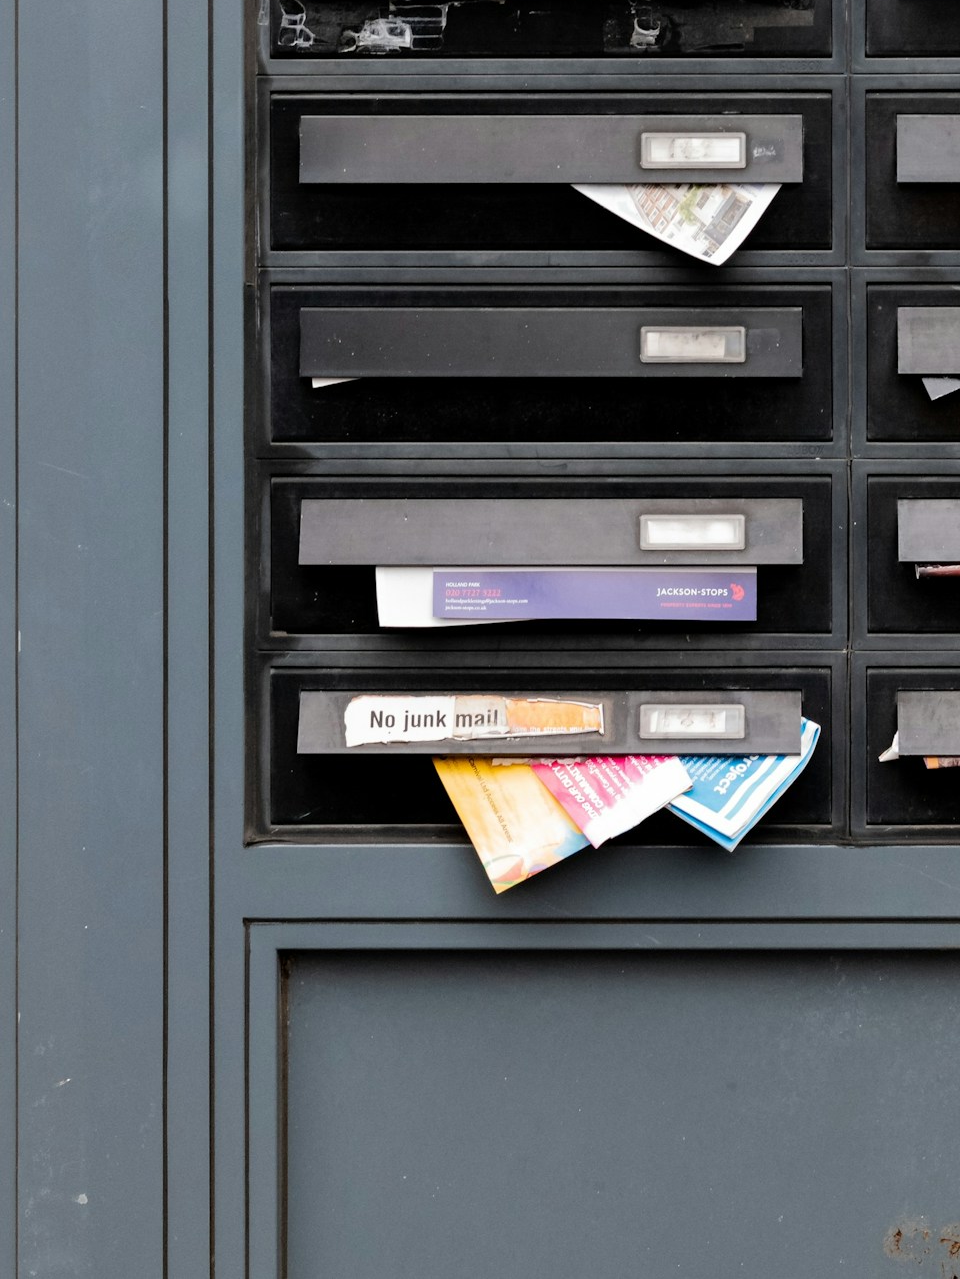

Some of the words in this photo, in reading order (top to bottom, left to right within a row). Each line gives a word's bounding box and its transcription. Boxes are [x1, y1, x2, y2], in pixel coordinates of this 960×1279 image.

[370, 710, 395, 729] No
[403, 710, 447, 732] junk
[455, 709, 498, 728] mail
[551, 763, 573, 789] DUTY
[565, 760, 604, 809] COMMUNIT
[568, 784, 585, 804] OUR
